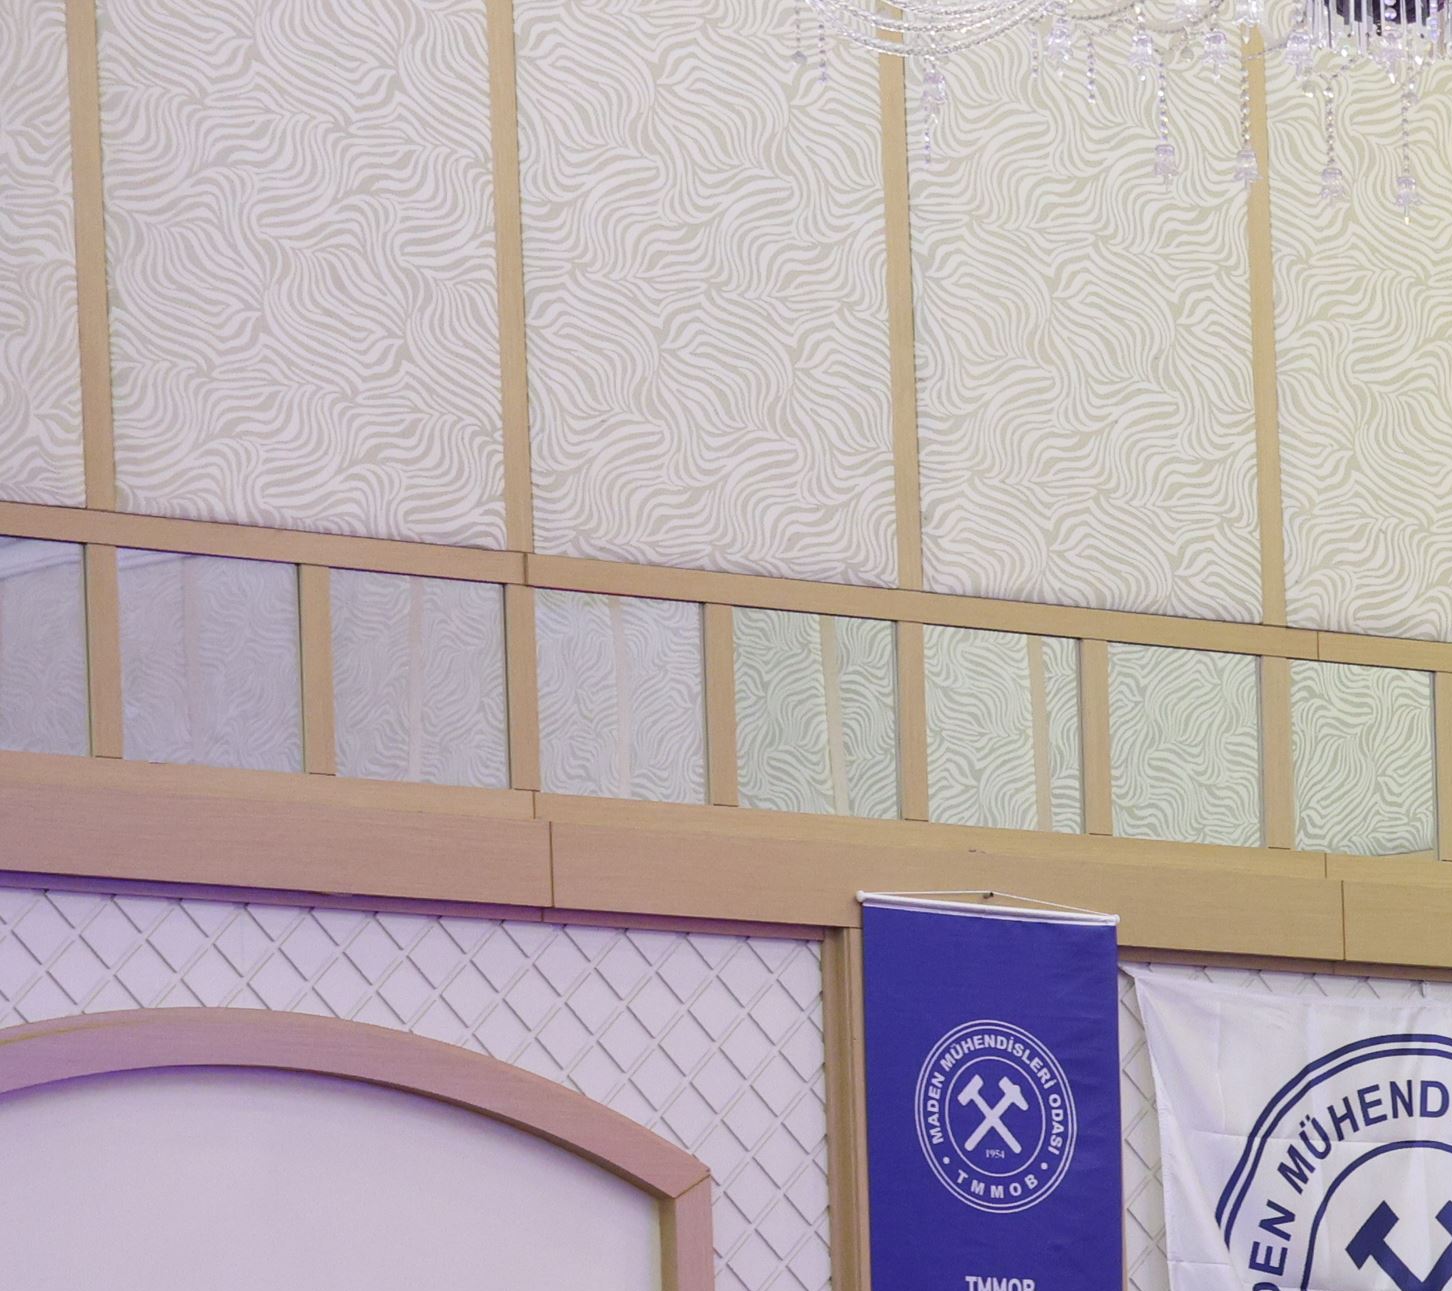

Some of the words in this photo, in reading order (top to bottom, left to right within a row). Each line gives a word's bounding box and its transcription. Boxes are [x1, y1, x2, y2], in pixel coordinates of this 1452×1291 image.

[928, 1074, 945, 1145] MADEN
[1047, 1093, 1063, 1155] ODASI
[957, 1169, 1038, 1198] TMMOB
